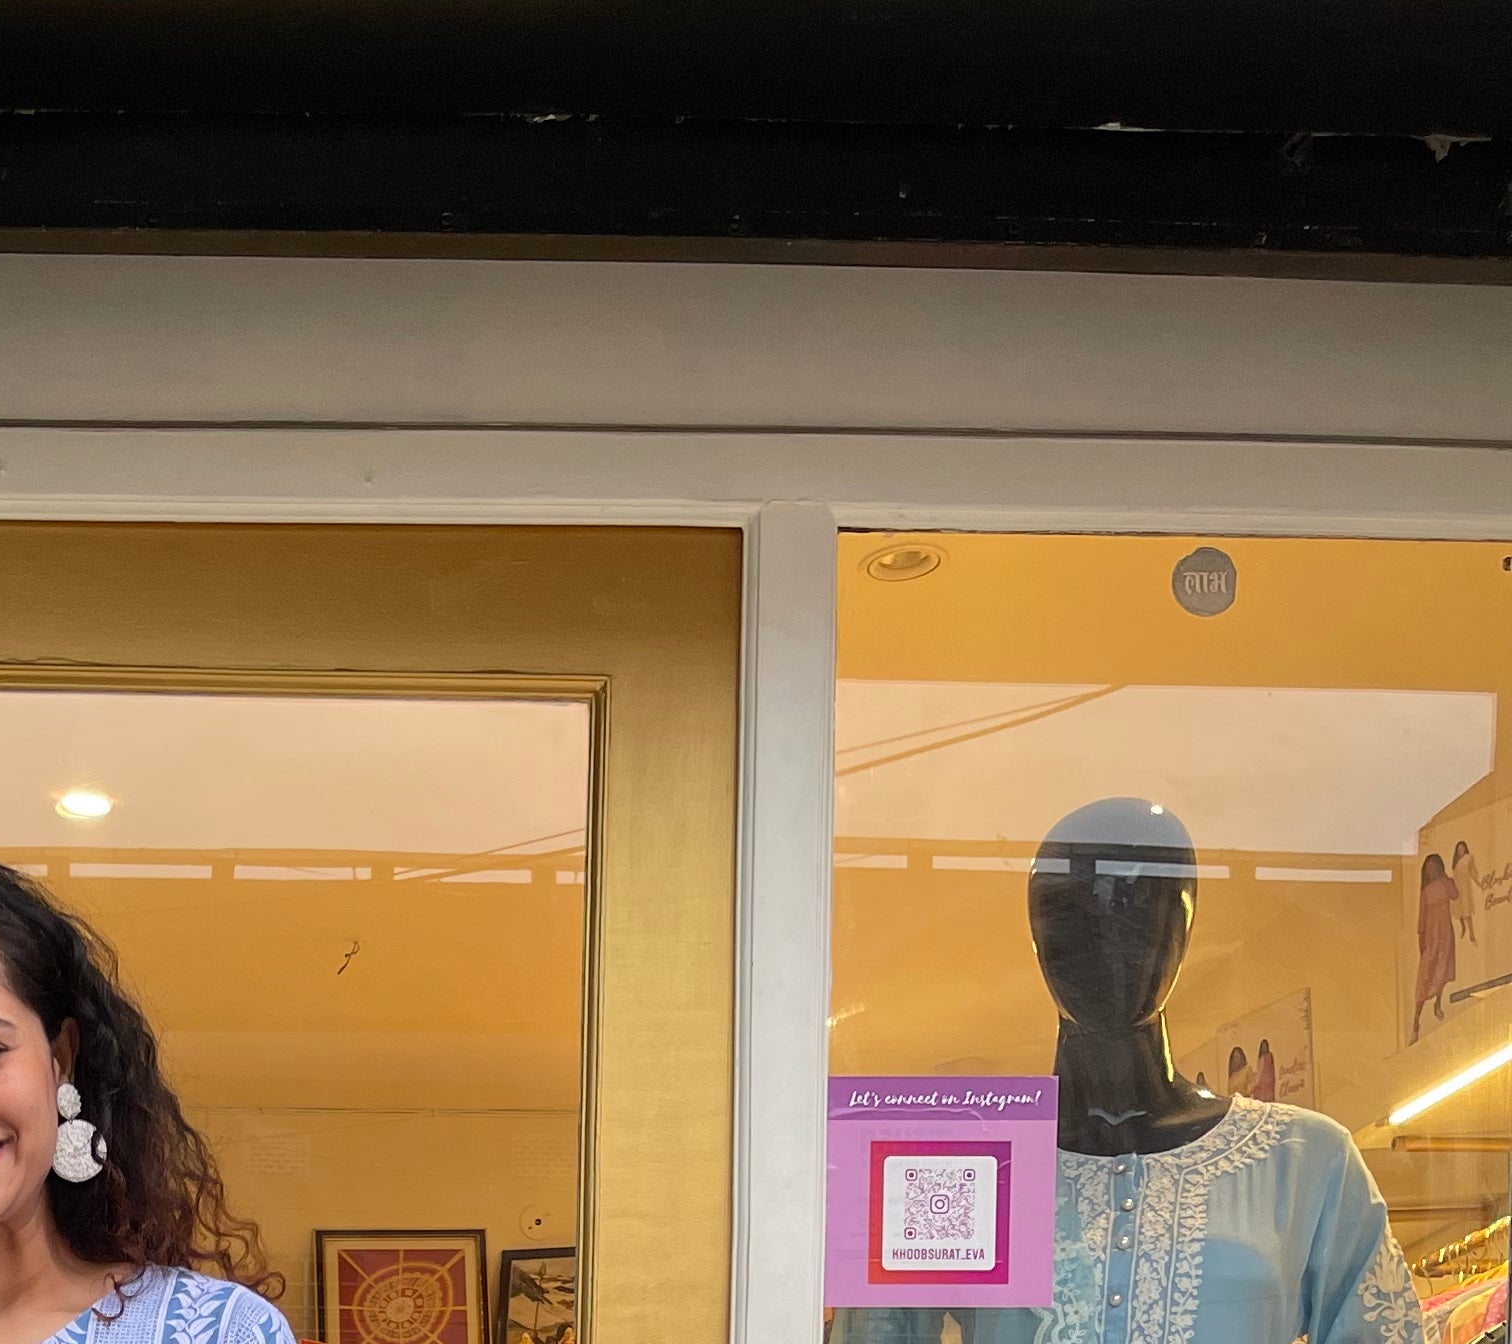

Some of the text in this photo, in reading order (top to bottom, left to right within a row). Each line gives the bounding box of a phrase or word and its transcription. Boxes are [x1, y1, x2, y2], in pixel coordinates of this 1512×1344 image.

[1182, 571, 1228, 595] लाभ
[848, 1089, 1042, 1112] Let's connect on Instagram!
[891, 1247, 986, 1260] KHOOBSURAT_EVA
